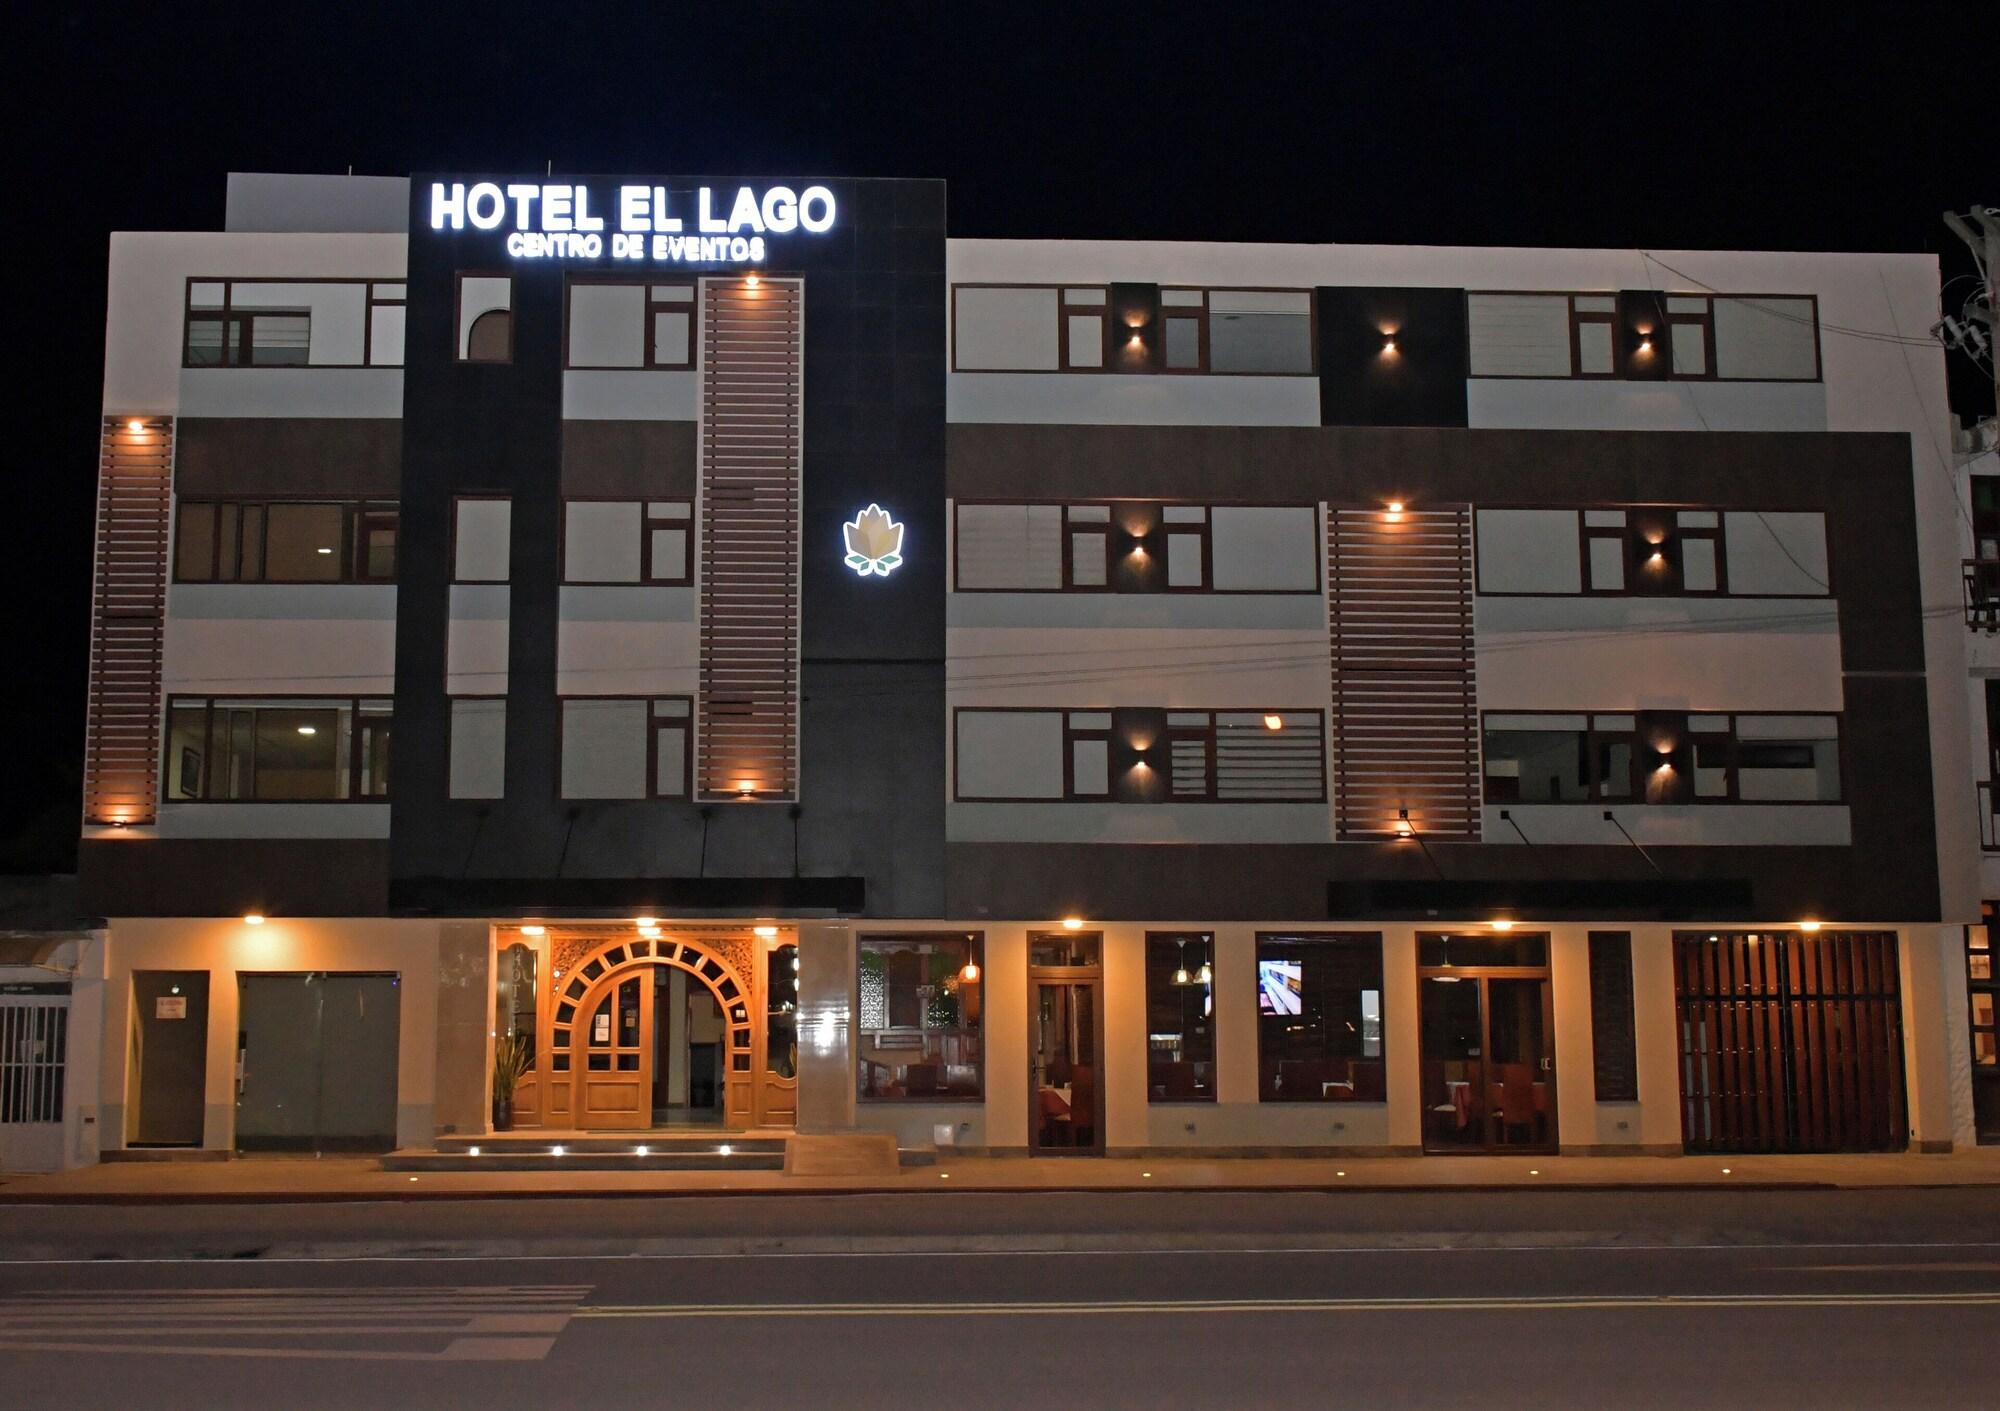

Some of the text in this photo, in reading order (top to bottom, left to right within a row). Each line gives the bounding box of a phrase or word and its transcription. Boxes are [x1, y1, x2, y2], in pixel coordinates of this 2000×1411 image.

[431, 183, 836, 232] HOTEL EL LAGO
[507, 233, 765, 262] CENTRO DE EVENTOS
